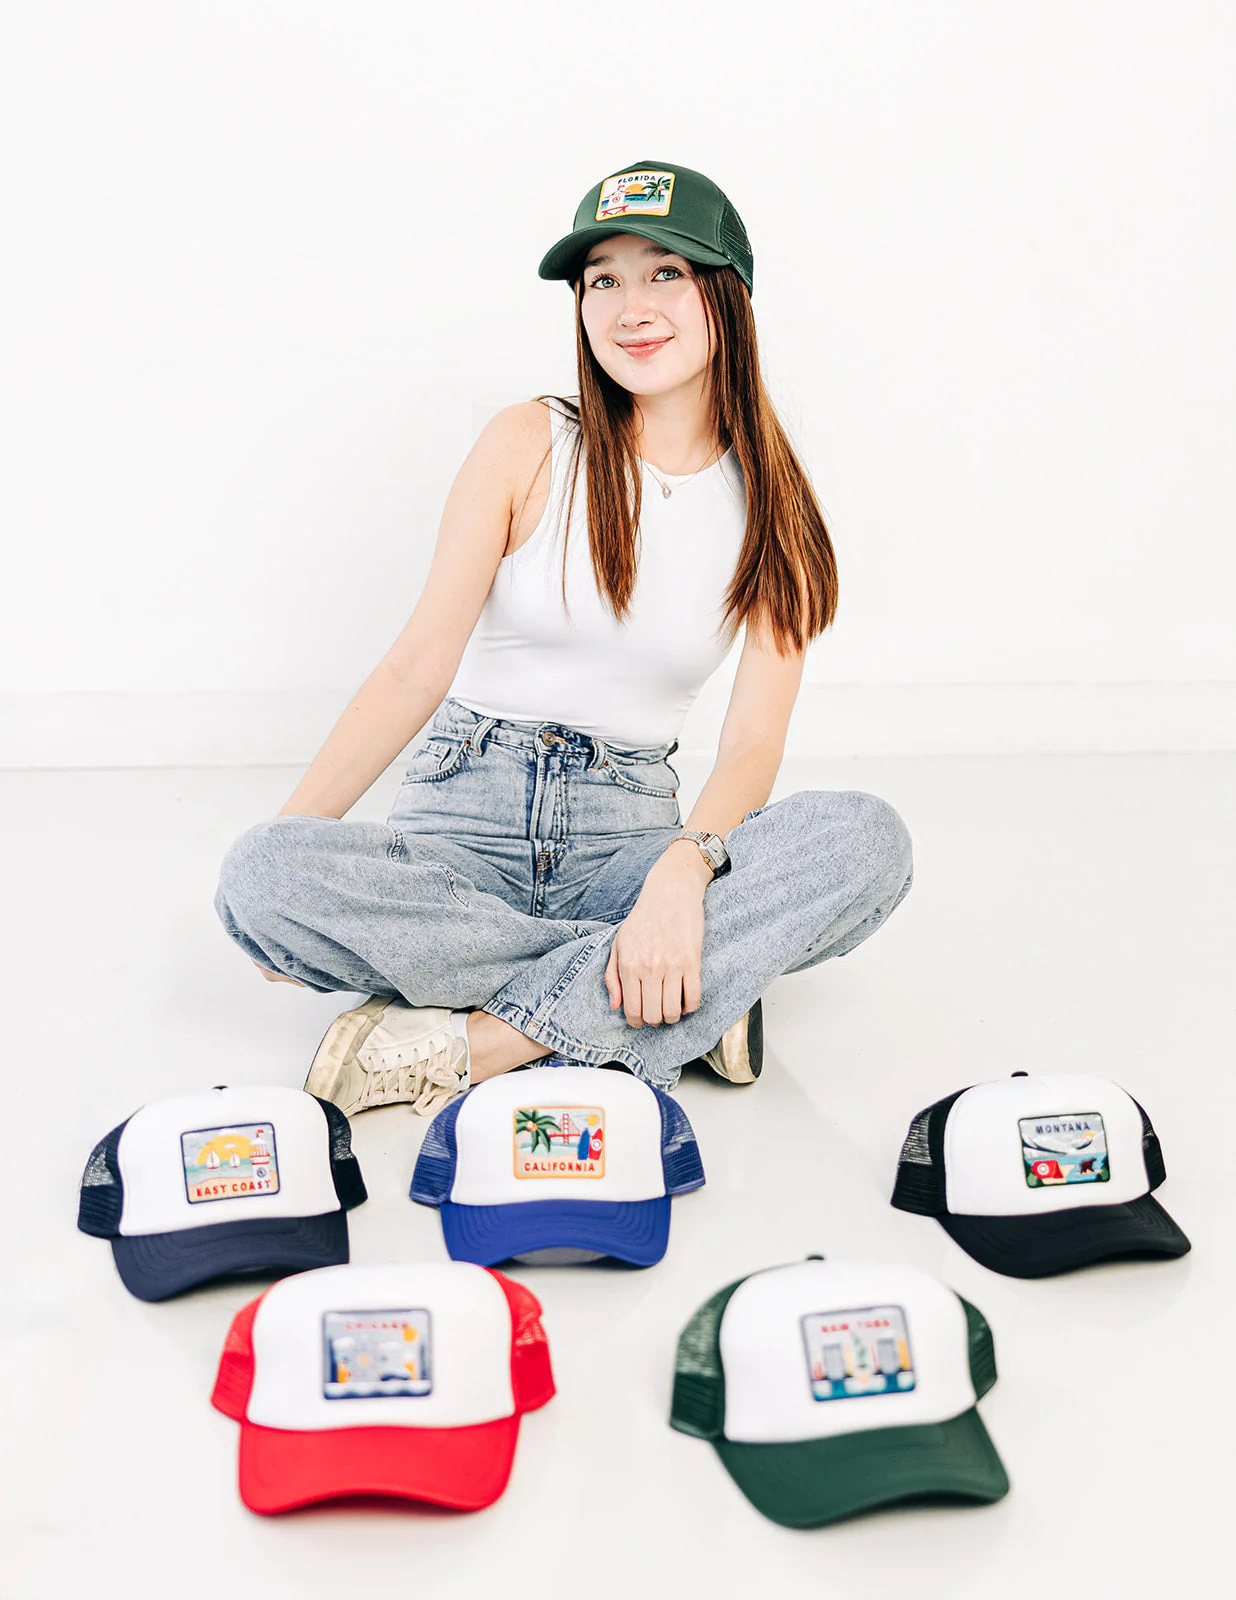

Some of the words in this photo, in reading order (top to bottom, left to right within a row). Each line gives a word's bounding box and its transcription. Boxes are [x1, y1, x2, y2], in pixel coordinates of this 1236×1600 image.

[617, 175, 656, 184] FLORIDA
[1035, 1121, 1091, 1134] MONTANA
[523, 1161, 596, 1172] CALIFORNIA
[196, 1184, 227, 1197] EAST
[231, 1180, 271, 1193] COAST
